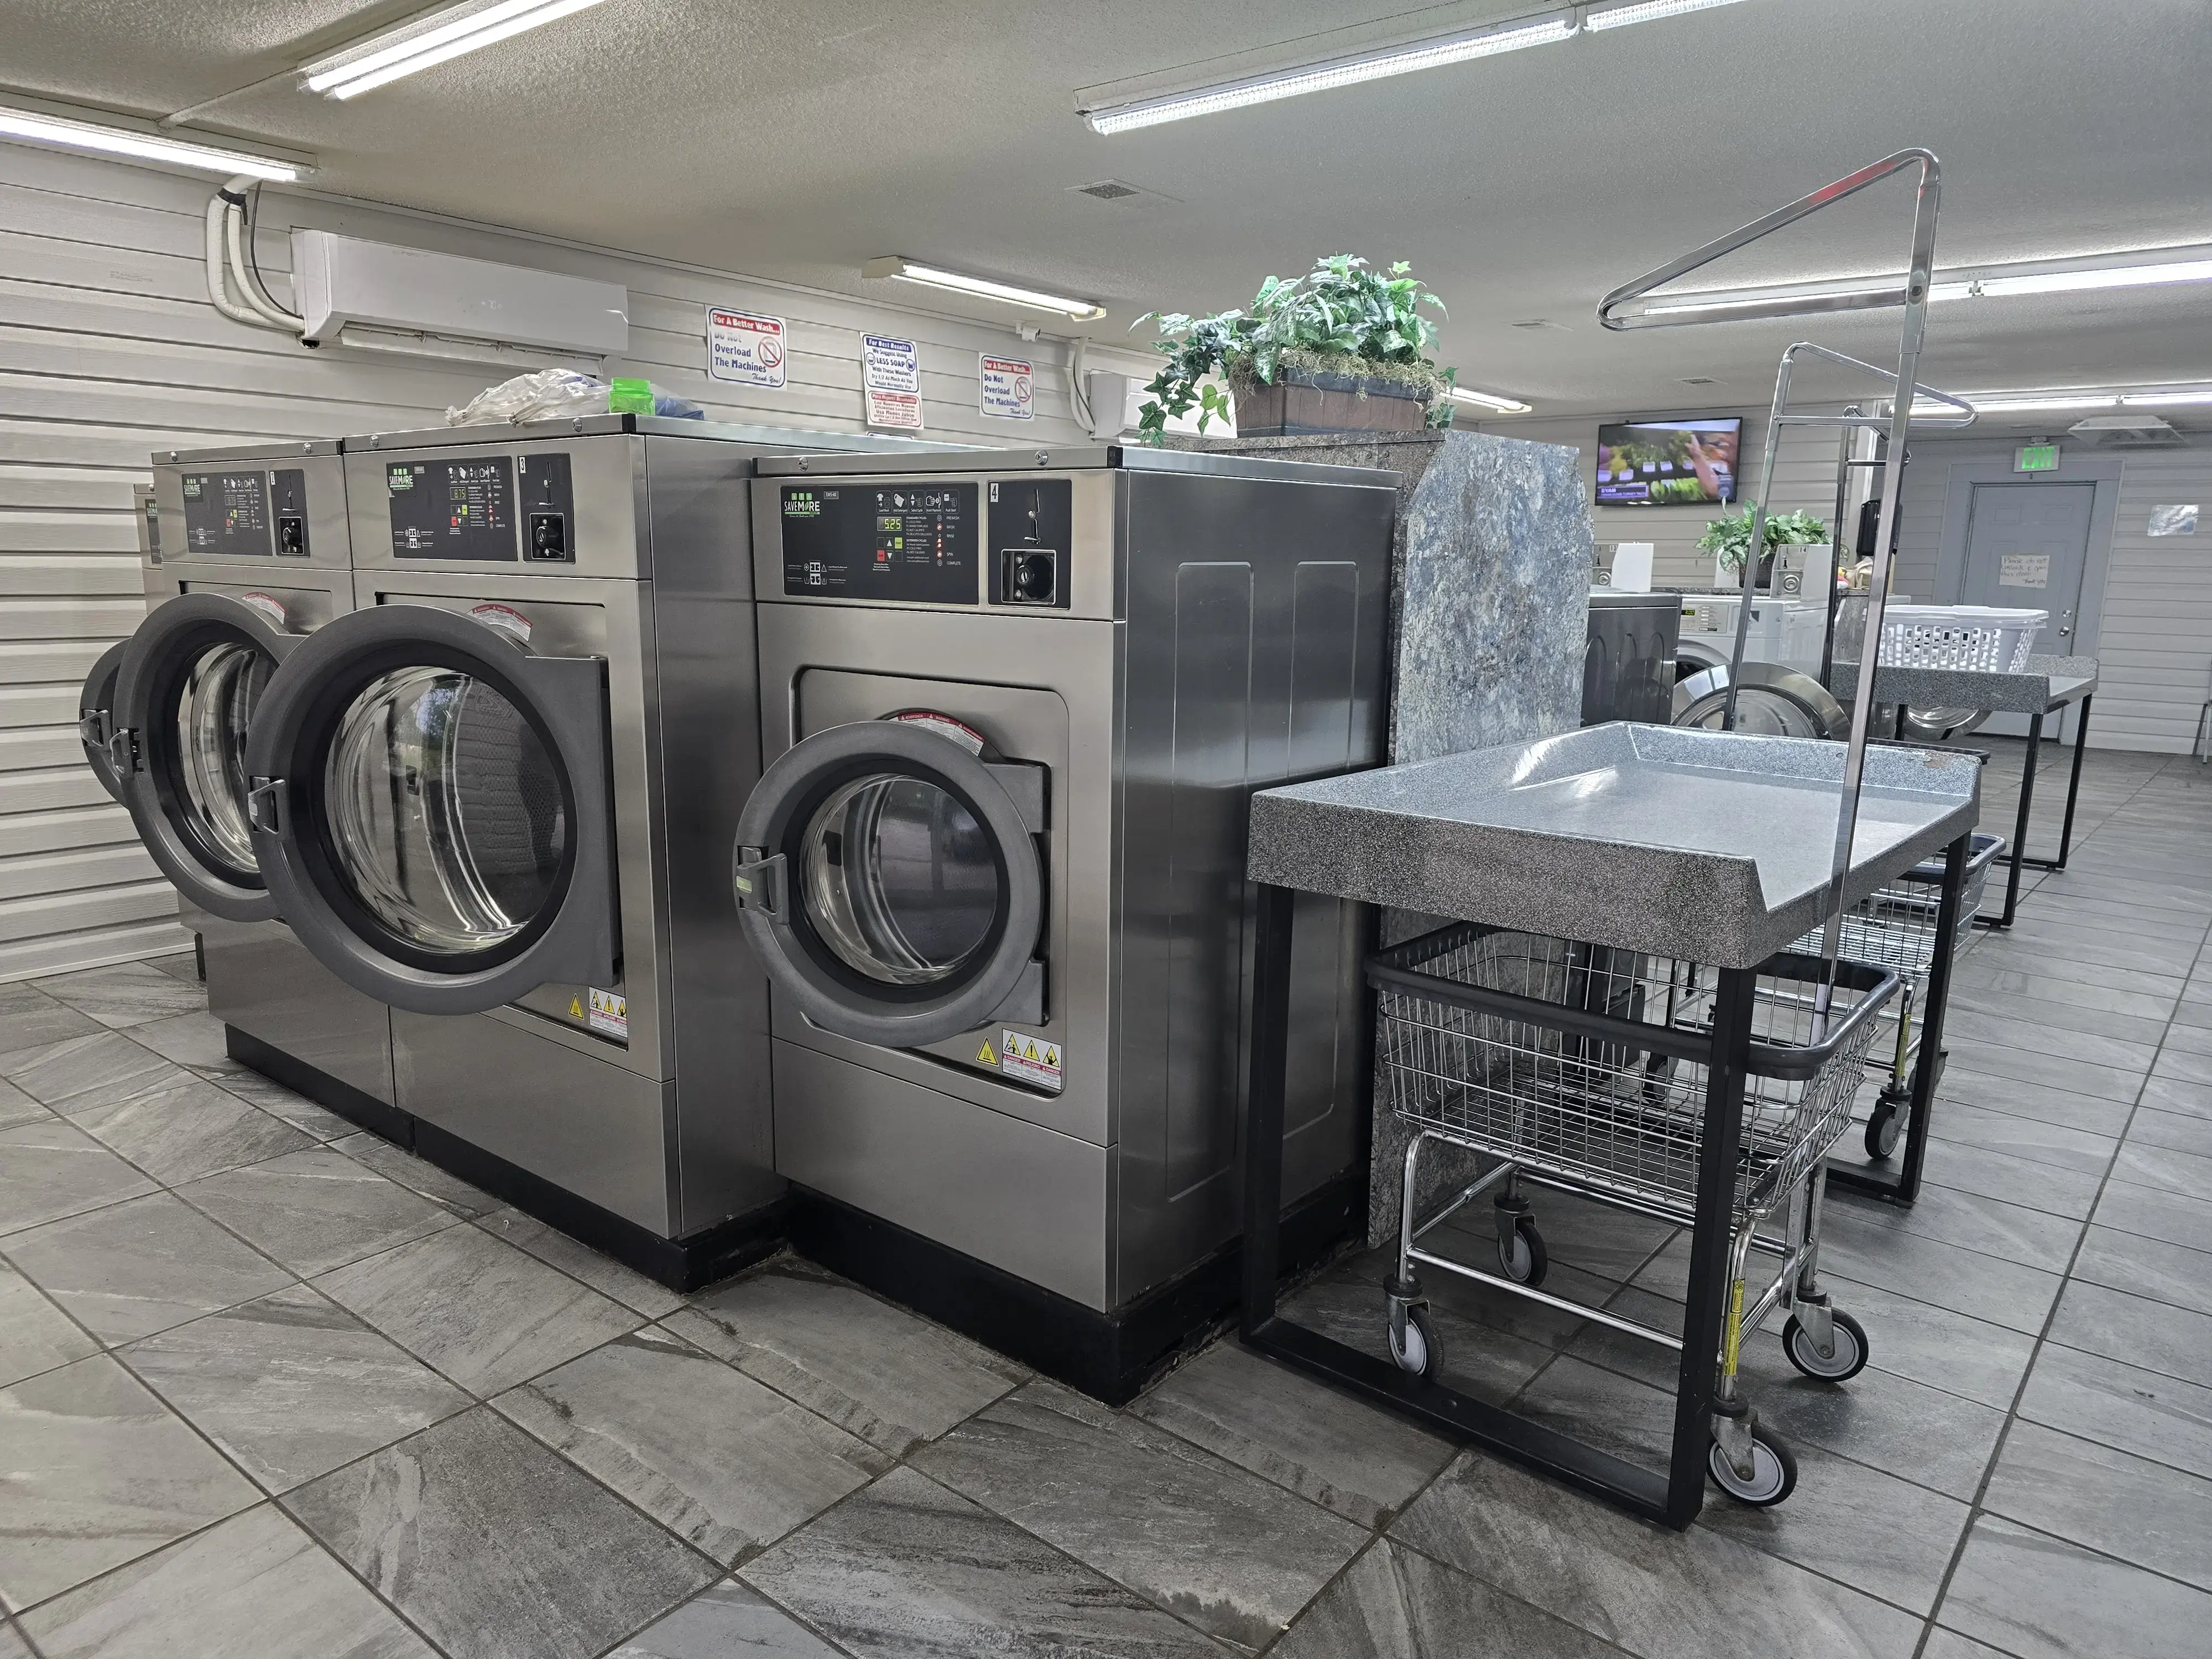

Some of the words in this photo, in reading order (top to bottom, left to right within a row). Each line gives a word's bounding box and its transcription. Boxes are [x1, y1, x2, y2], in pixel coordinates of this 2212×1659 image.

[713, 314, 724, 323] For
[733, 318, 754, 329] Better
[714, 343, 751, 358] Overload
[890, 342, 909, 351] Results
[714, 356, 729, 367] The
[732, 359, 766, 373] Machines
[876, 357, 889, 366] LESS
[890, 359, 905, 367] SOAP
[997, 363, 1013, 371] Better
[752, 373, 768, 382] Thank
[993, 374, 1004, 383] Not
[984, 385, 1010, 395] Overload
[984, 396, 994, 404] The
[996, 397, 1020, 408] Machines
[2021, 446, 2054, 469] EXIT
[520, 458, 524, 471] 3
[270, 473, 275, 483] 2
[992, 485, 997, 499] 4
[1007, 1055, 1021, 1063] DANGER
